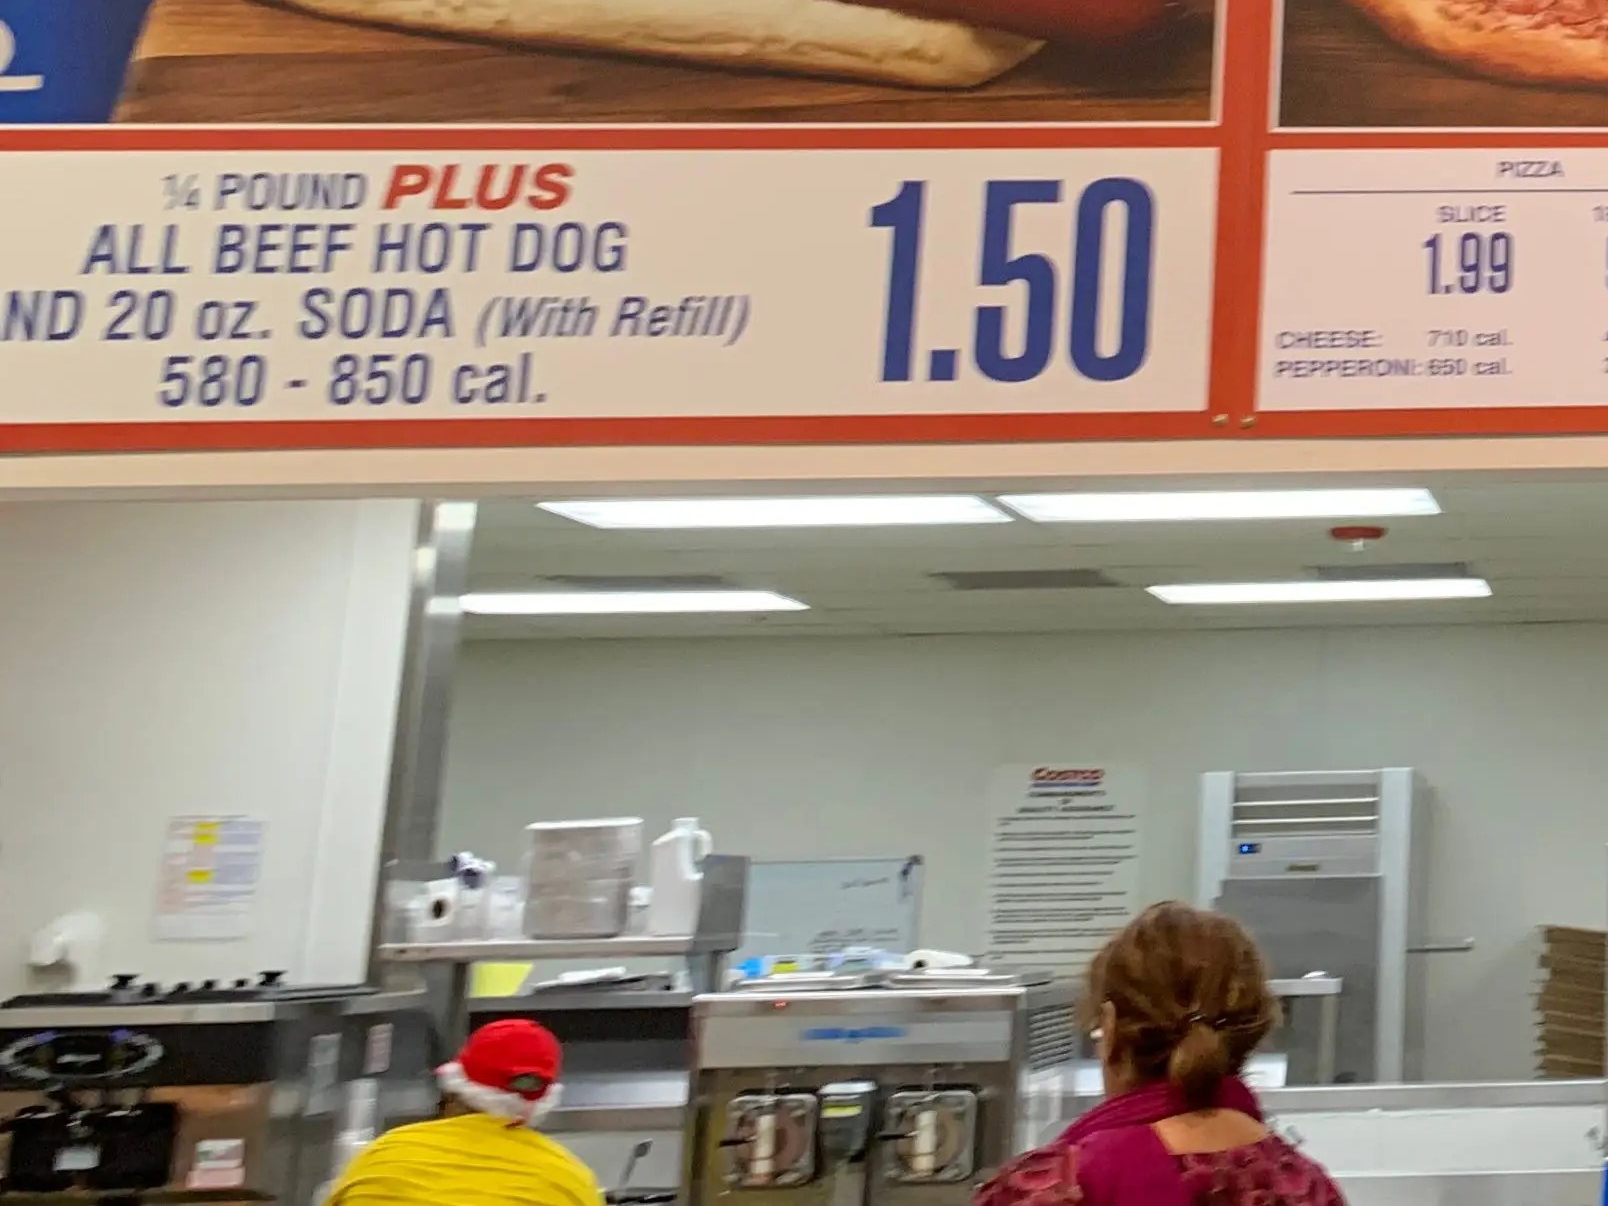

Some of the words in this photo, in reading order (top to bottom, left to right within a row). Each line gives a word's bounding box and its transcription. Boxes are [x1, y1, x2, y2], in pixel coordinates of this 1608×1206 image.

[216, 173, 366, 210] POUND
[382, 163, 574, 210] PLUS
[1498, 161, 1564, 178] PIZZA
[1438, 205, 1506, 223] SLICE
[81, 224, 189, 274] ALL
[214, 224, 355, 274] BEEF
[374, 222, 491, 273] HOT
[509, 222, 626, 273] DOG
[1421, 232, 1512, 294] 1.99
[870, 178, 1155, 382] 1.50
[104, 290, 174, 340] 20
[196, 301, 270, 340] oz.
[299, 288, 453, 339] SODA
[474, 295, 600, 347] (With
[608, 294, 750, 347] Refill)
[1428, 330, 1468, 347] 710
[161, 355, 265, 407] 580
[329, 354, 431, 405] 850
[453, 353, 545, 404] cal.
